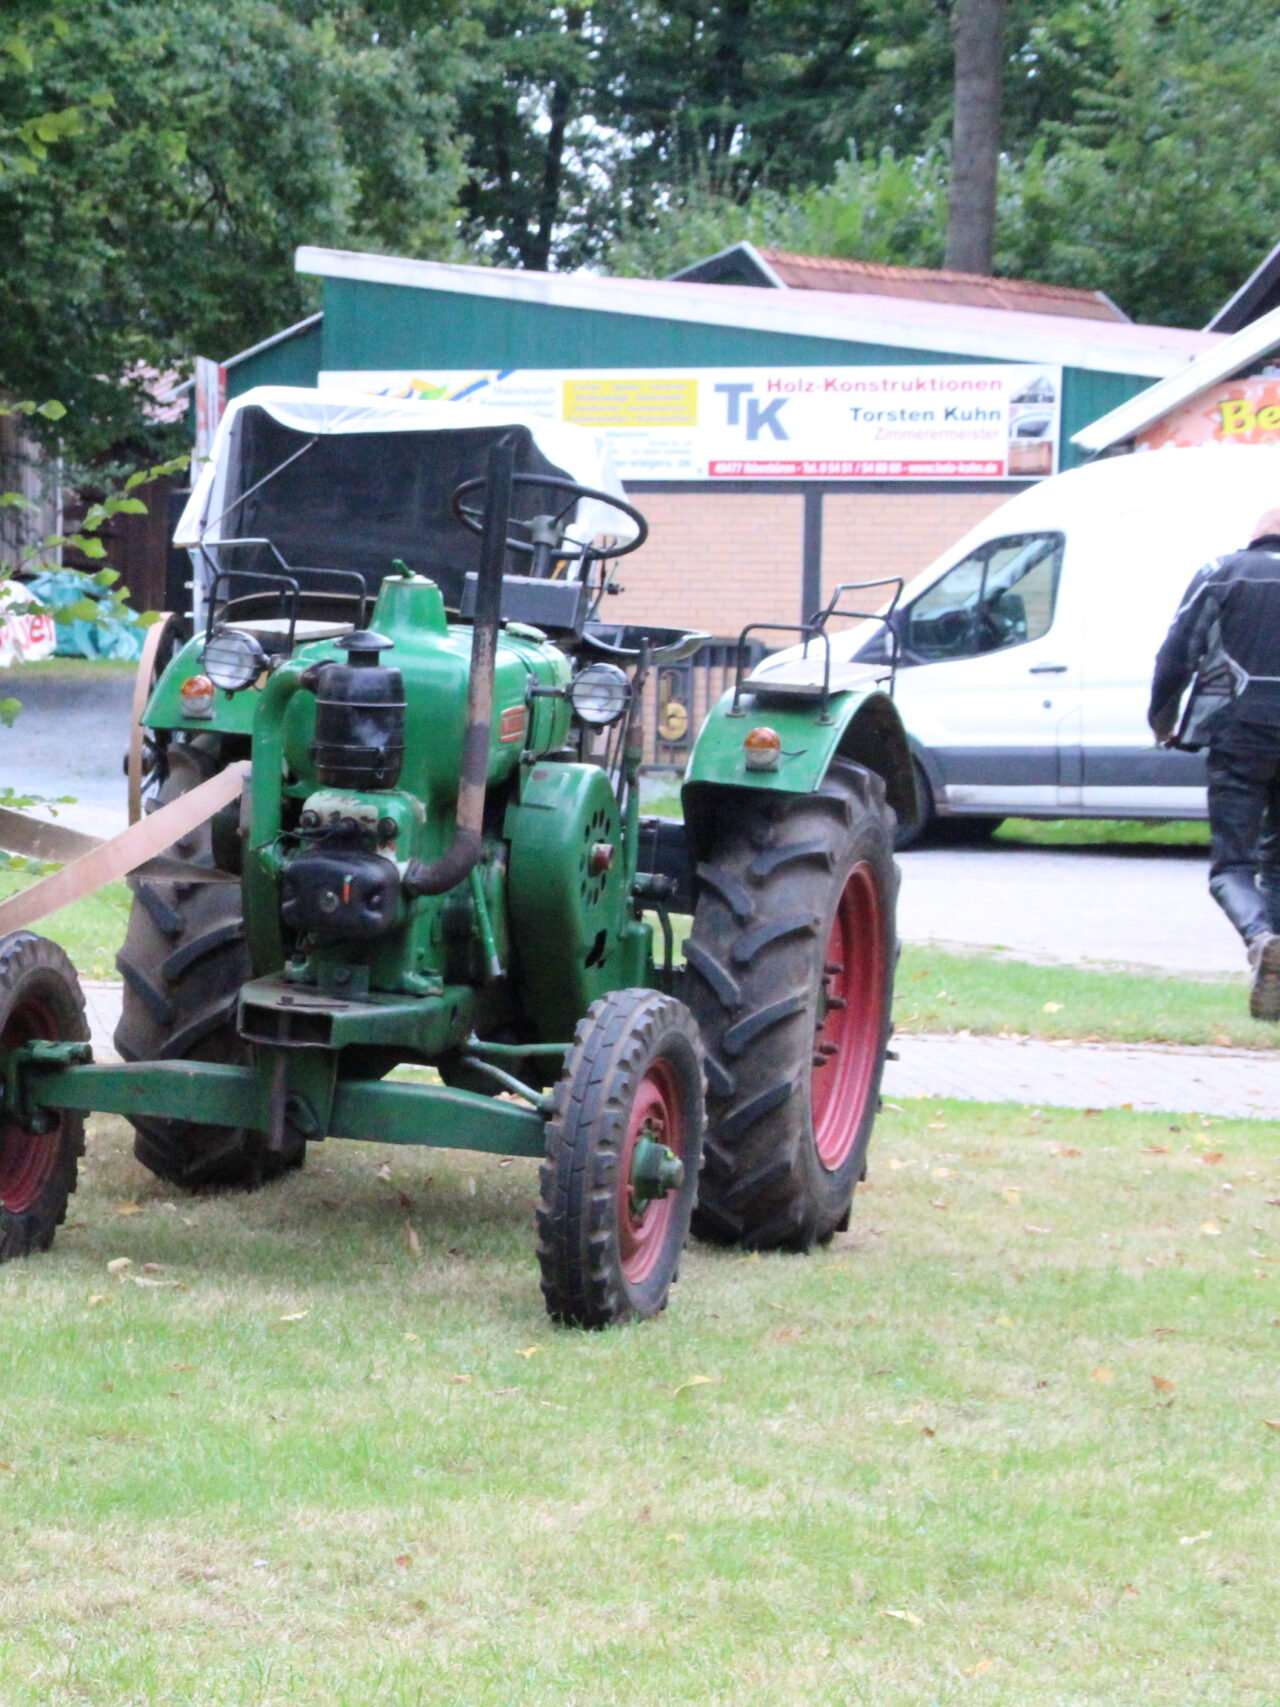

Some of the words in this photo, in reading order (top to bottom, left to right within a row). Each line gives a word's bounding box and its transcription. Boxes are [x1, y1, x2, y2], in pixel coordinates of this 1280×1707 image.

[767, 377, 1003, 394] Holz-Konstruktionen
[714, 383, 791, 441] TK
[849, 407, 934, 423] Torsten
[944, 406, 1001, 423] Kuhn
[874, 427, 1000, 441] Zimmerermeister
